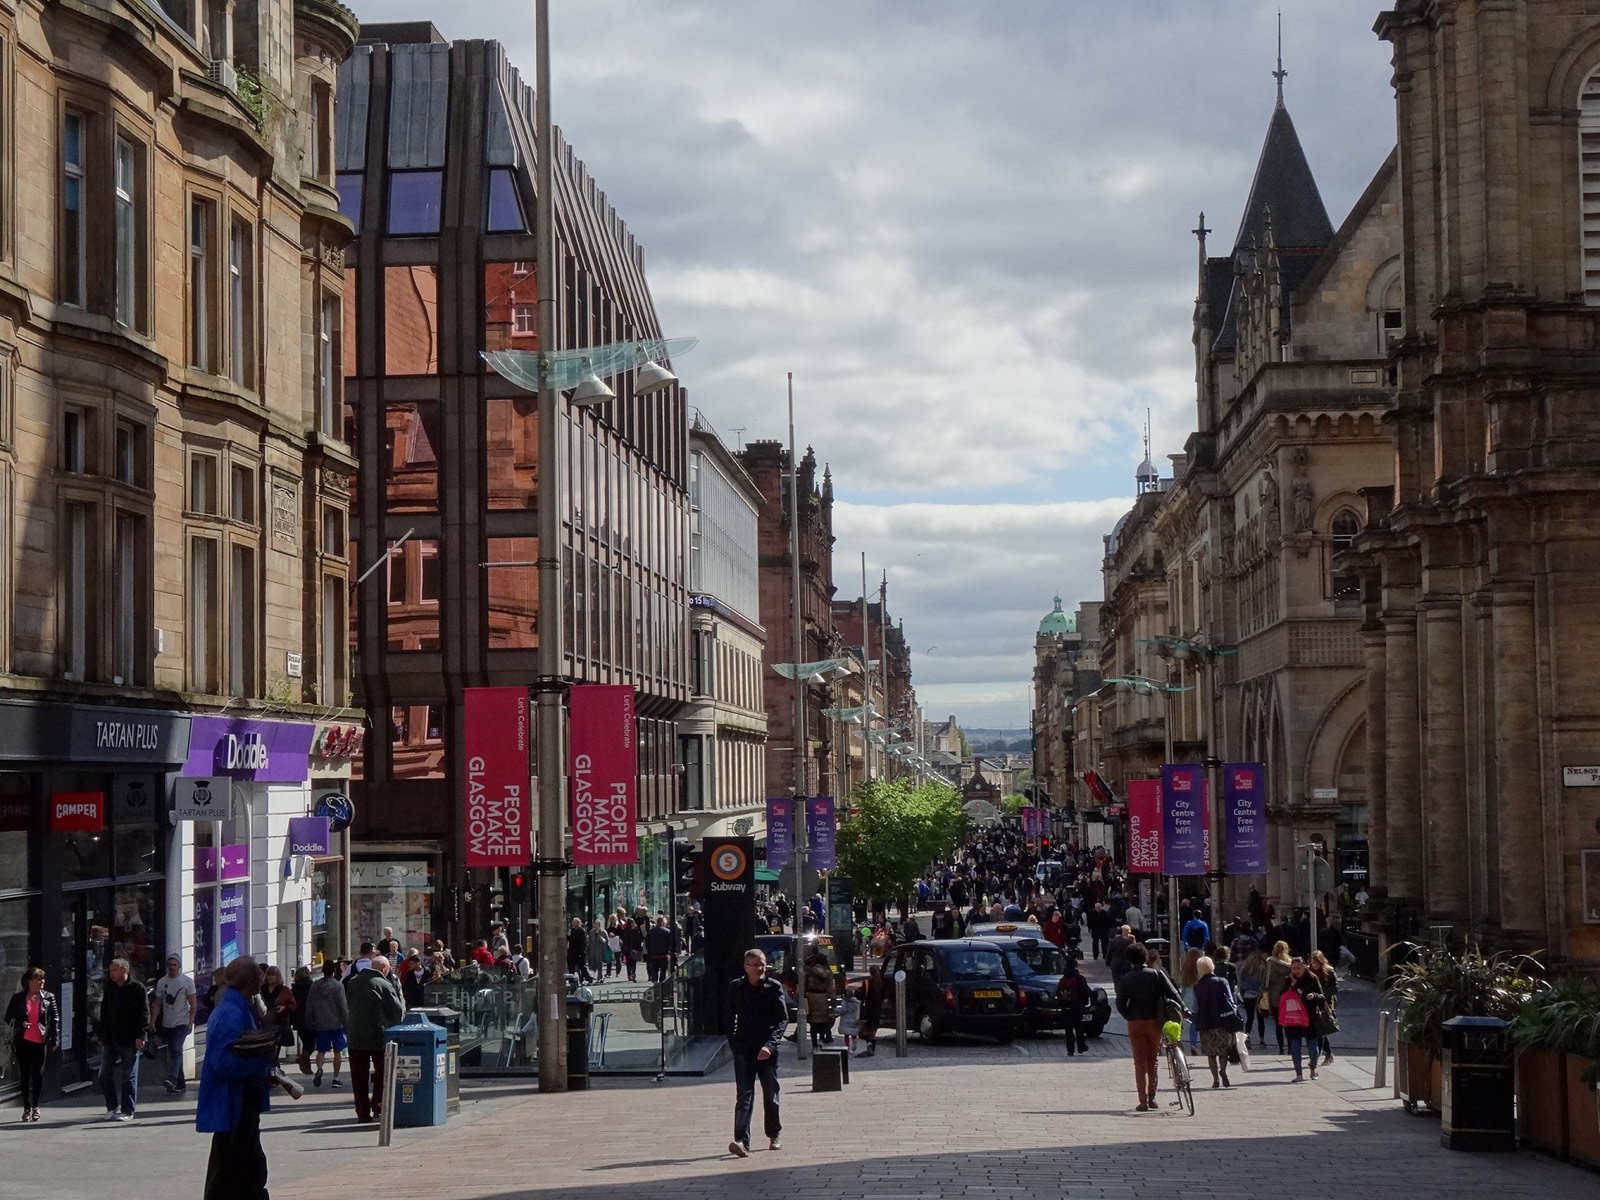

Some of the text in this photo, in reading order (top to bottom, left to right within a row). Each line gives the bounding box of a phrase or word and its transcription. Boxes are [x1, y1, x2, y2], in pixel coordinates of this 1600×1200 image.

[694, 596, 702, 605] 15
[96, 721, 159, 749] TARTAN PLUS
[226, 733, 269, 769] Doddle.
[468, 756, 486, 856] GLASGOW
[575, 754, 593, 854] GLASGOW
[1175, 800, 1190, 809] City
[1237, 799, 1252, 808] City
[56, 803, 97, 819] CAMPER
[178, 808, 226, 817] TARTAN PLUS
[610, 782, 628, 853] PEOPLE
[1233, 808, 1257, 816] Centre
[504, 785, 521, 855] PEOPLE
[593, 798, 610, 854] MAKE
[1237, 817, 1253, 825] Free
[487, 800, 504, 856] MAKE
[1175, 826, 1192, 834] WiFi
[1237, 825, 1254, 833] WiFi
[292, 843, 325, 852] Doddle.
[1131, 815, 1141, 867] GLASGOW
[1140, 838, 1150, 867] MAKE
[1149, 830, 1159, 867] PEOPLE
[724, 856, 734, 868] S
[375, 867, 424, 878] LOOK
[710, 881, 747, 893] Subway
